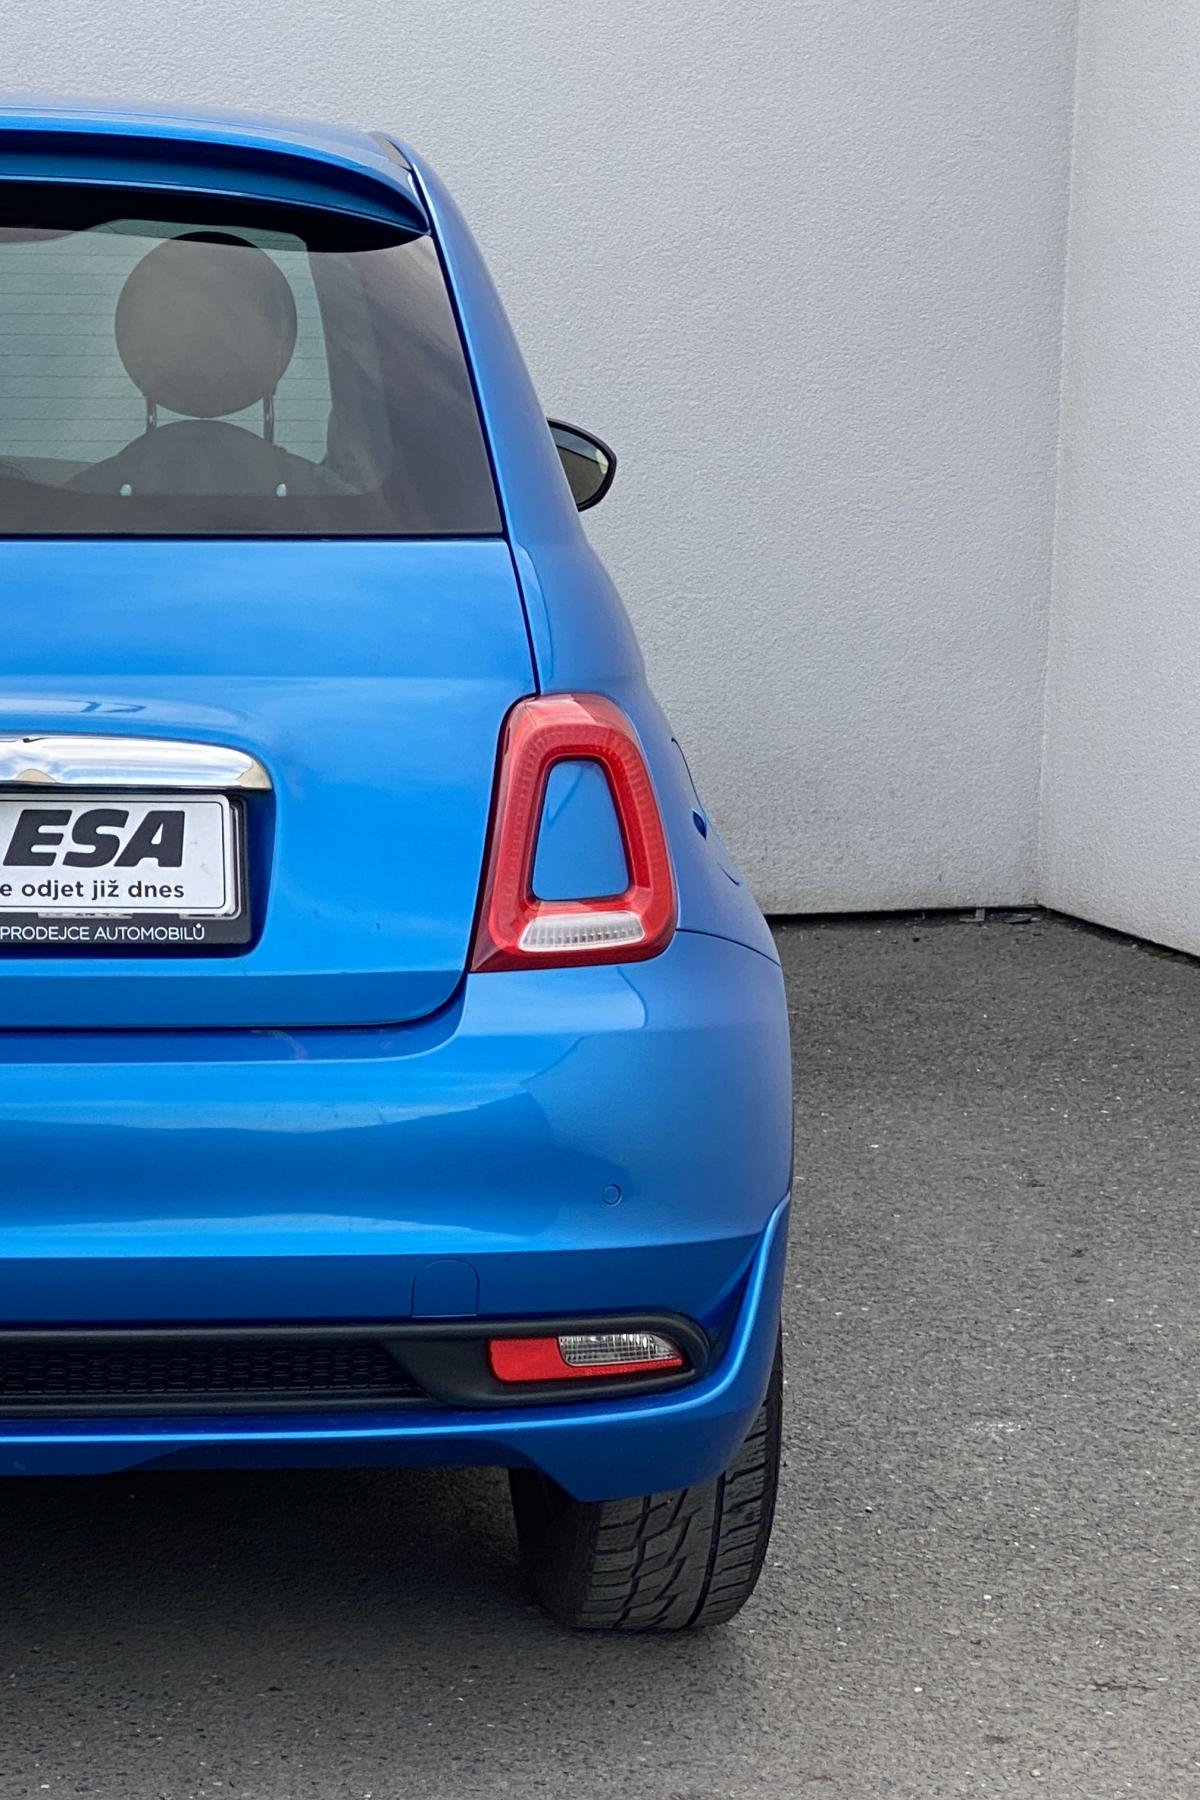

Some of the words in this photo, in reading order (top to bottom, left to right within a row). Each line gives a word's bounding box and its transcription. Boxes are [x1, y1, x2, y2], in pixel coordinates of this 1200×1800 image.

[2, 808, 186, 868] ESA
[21, 880, 84, 901] odjet
[91, 879, 120, 901] již
[128, 880, 185, 898] dnes
[0, 926, 90, 941] PRODEJCE
[93, 924, 205, 941] AUTOMOBILŮ
